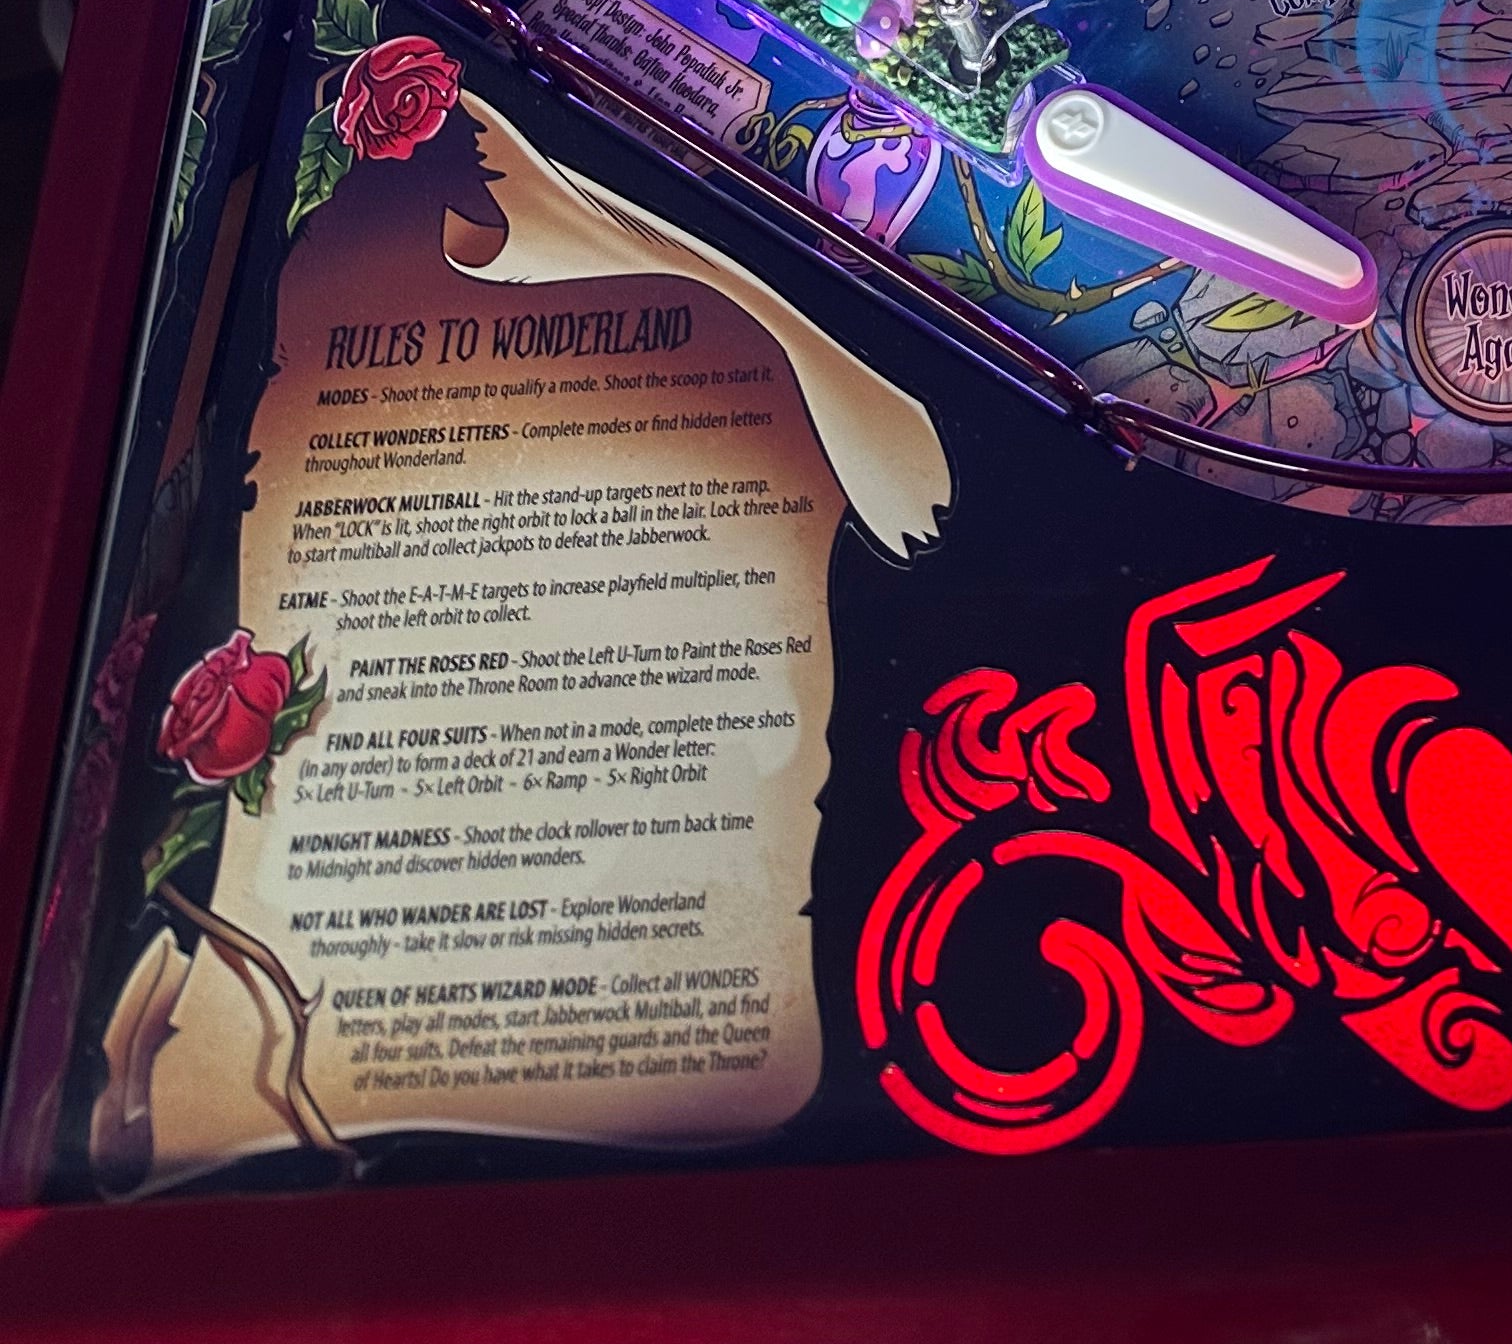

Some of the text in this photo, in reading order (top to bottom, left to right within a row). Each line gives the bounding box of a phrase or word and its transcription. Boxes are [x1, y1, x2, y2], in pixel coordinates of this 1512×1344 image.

[590, 21, 634, 62] Thanks:
[604, 0, 648, 39] Design:
[645, 28, 677, 57] John
[724, 79, 745, 102] Jr.
[325, 306, 691, 369] RULES TO WONDERLAND
[316, 364, 774, 406] MODES Shoot the ramp to qualify a mode. Shoot the scoop to start it.
[308, 409, 773, 450] COLLECT WONDERS LETTERS Complete modes or find hidden letters
[304, 447, 466, 474] throughout Wonderland.
[295, 477, 770, 517] JABBERWOCK MULTIBALL Hit the stand-up targets next to the ramp.
[278, 566, 776, 610] EATME Shoot the E-A-T-M-E targets to increase playfield multiplier, then
[349, 634, 812, 677] PAINT THE ROSES RED Shoot the Left U-Turn to Paint the Roses Red
[289, 812, 754, 853] MIDNIGHT MADNESS Shoot the clock rollover to turn back time
